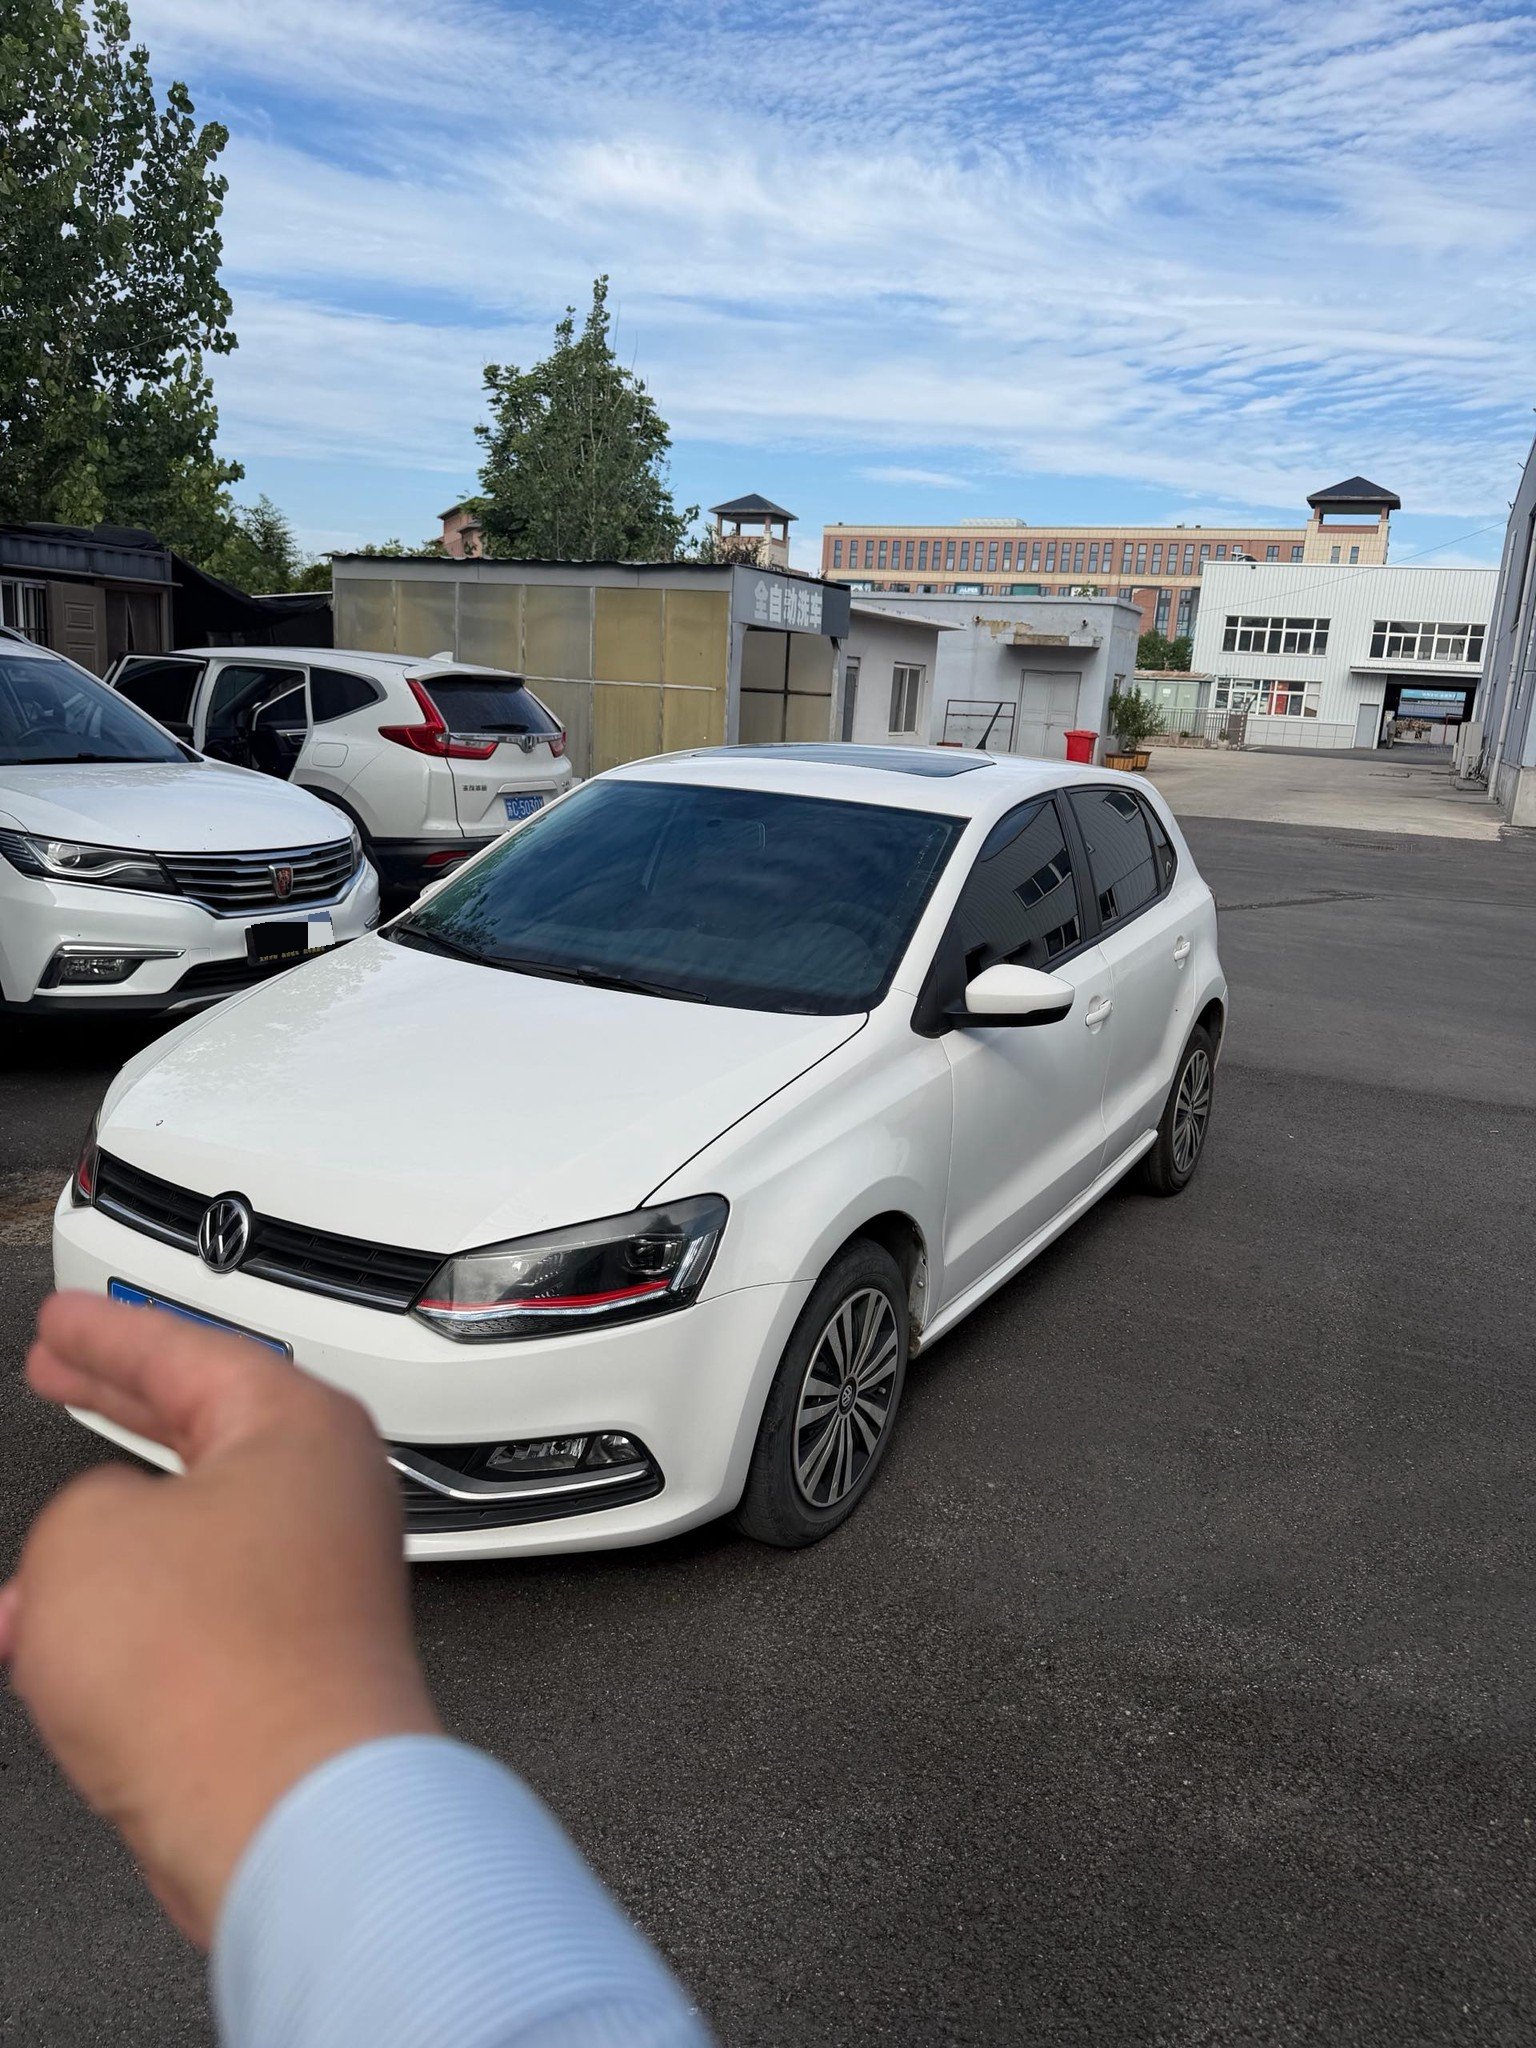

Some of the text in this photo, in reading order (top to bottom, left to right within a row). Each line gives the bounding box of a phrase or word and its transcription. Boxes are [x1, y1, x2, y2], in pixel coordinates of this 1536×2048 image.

[754, 579, 822, 628] 全自动洗车
